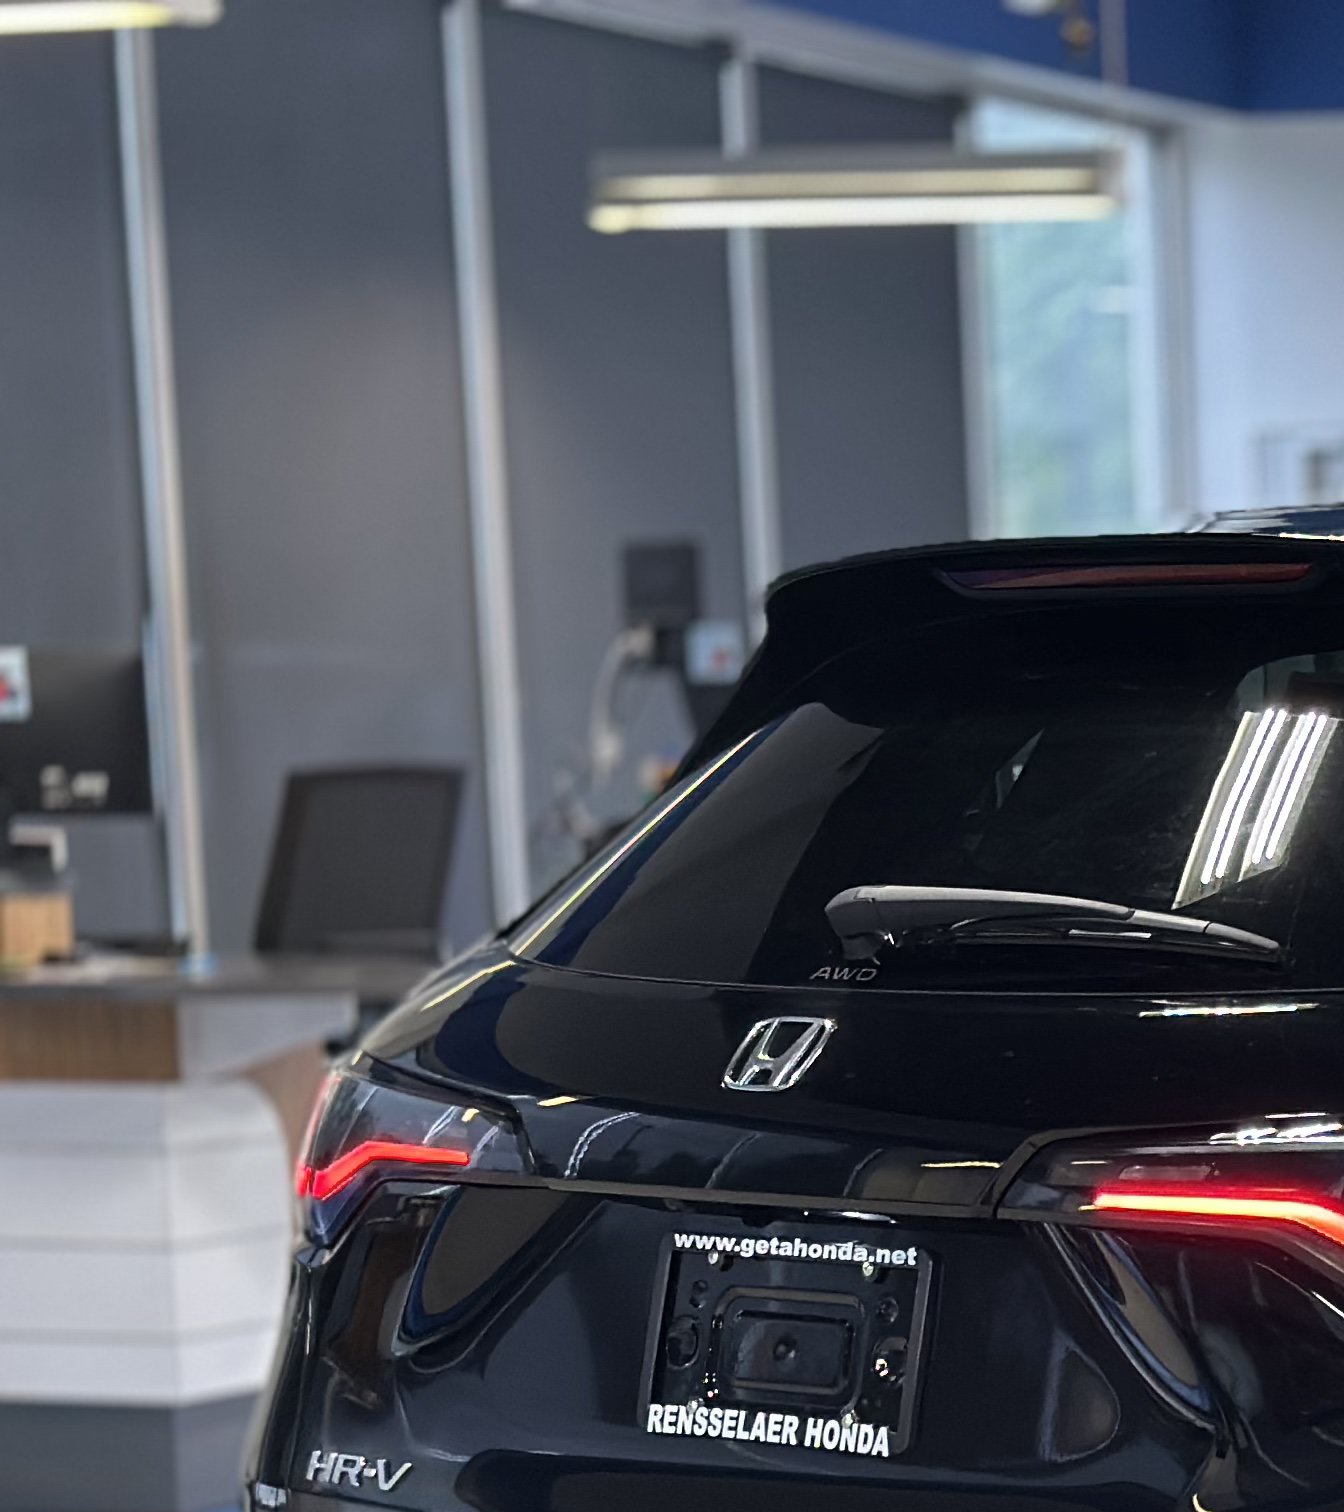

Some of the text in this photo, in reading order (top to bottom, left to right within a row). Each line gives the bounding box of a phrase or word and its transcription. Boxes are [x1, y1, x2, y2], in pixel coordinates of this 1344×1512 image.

[809, 966, 878, 981] AWD
[674, 1232, 918, 1266] www.getahonda.net
[647, 1403, 890, 1458] RENSSELAER HONDA
[306, 1450, 413, 1491] HR-V
